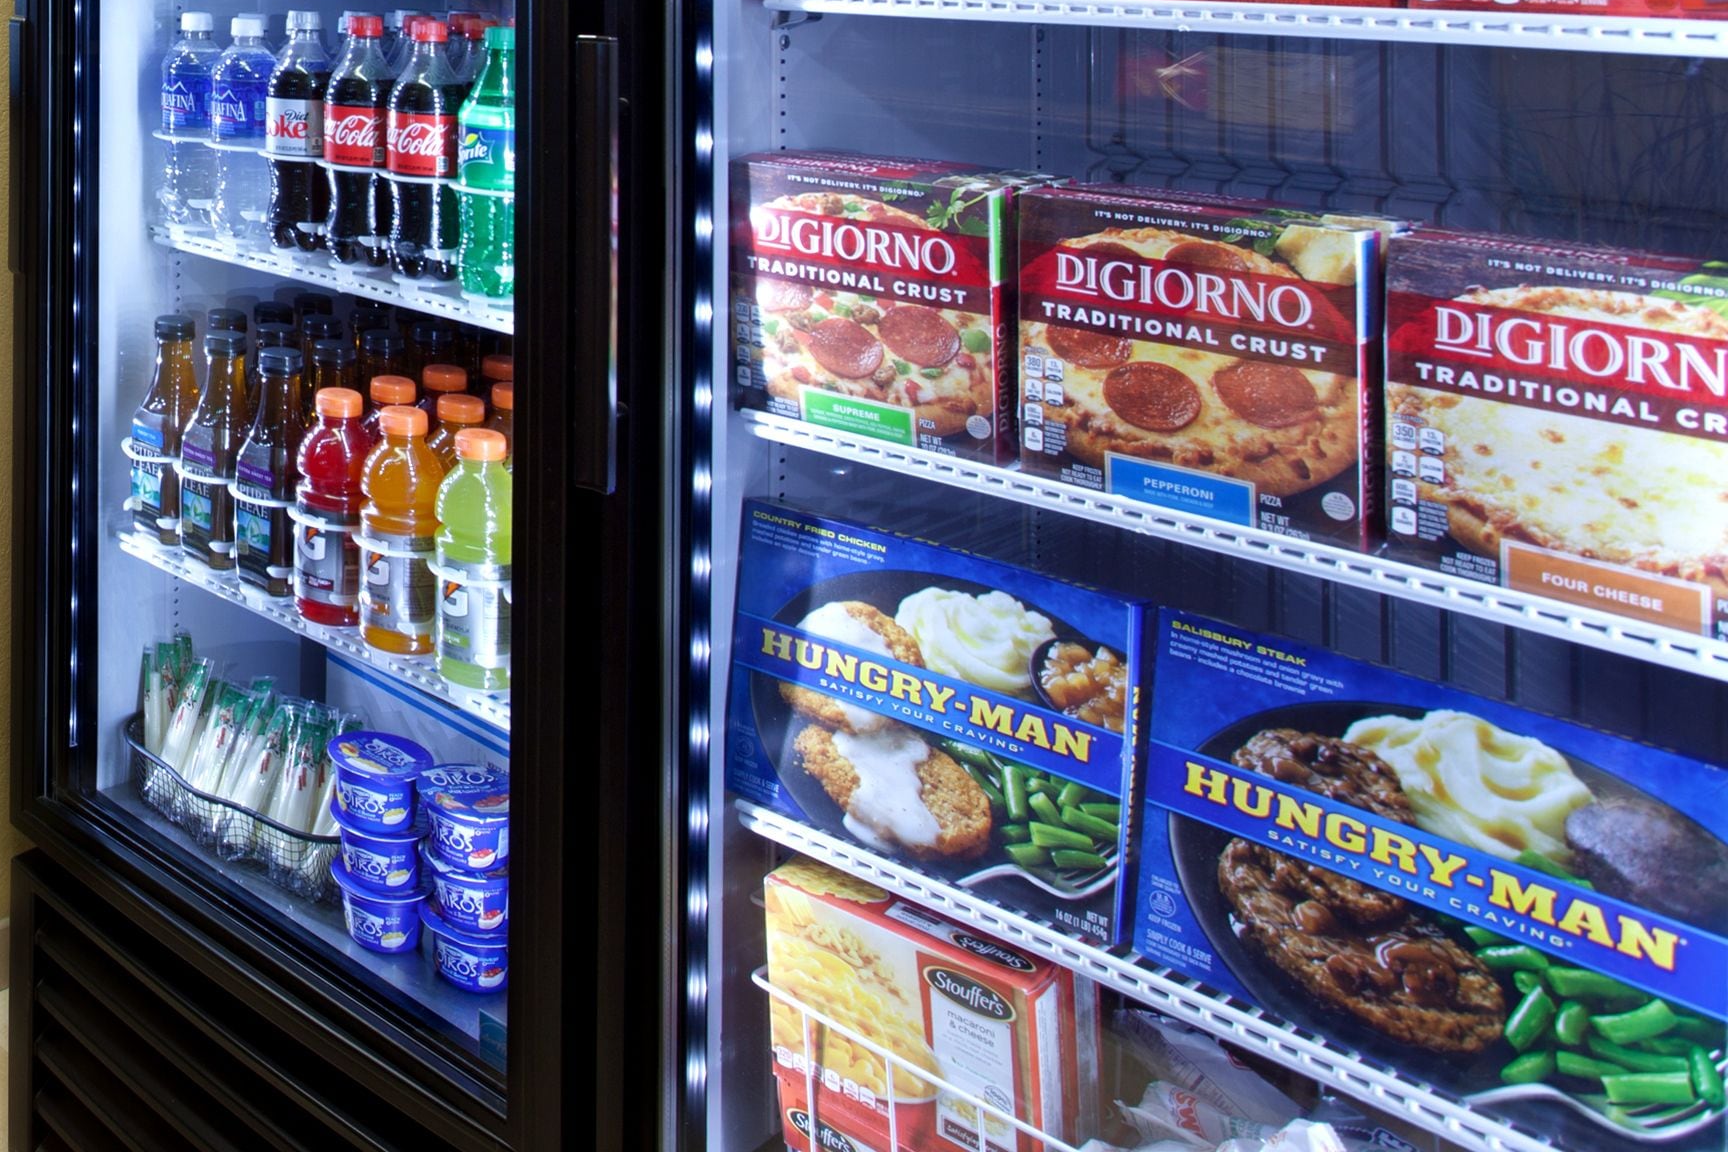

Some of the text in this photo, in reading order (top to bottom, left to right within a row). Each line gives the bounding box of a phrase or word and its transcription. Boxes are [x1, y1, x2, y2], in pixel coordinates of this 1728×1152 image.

[284, 108, 310, 121] Diet
[803, 176, 819, 185] NOT
[1094, 210, 1210, 231] IT'S NOT IT'S
[747, 255, 967, 305] TRADITIONAL CRUST
[1488, 259, 1512, 269] IT'S
[1515, 262, 1542, 274] NOT
[1620, 276, 1647, 288] IT'S
[1041, 301, 1327, 363] TRADITIONAL CRUST
[1414, 361, 1659, 423] TRADITIONAL
[832, 403, 881, 422] SUPREME
[919, 418, 936, 430] PIZZA
[1395, 423, 1415, 439] 350
[1143, 477, 1215, 501] PEPPERONI
[1260, 493, 1282, 508] PIZZA
[753, 510, 887, 553] COUNTRY FRIED CHICKEN
[1541, 571, 1664, 612] FOUR CHEESE
[1171, 620, 1307, 667] SALISBURY STEAK
[760, 627, 1094, 764] HUNGRY-MAN
[819, 678, 1020, 753] SATISFY YOUR CRAVING
[1182, 760, 1678, 973] HUNGRY-MAN
[1267, 828, 1567, 948] SATISFY YOUR CRAVING
[934, 971, 1005, 1018] Stouffer's
[947, 1009, 996, 1039] macaroni
[958, 1022, 996, 1048] cheese
